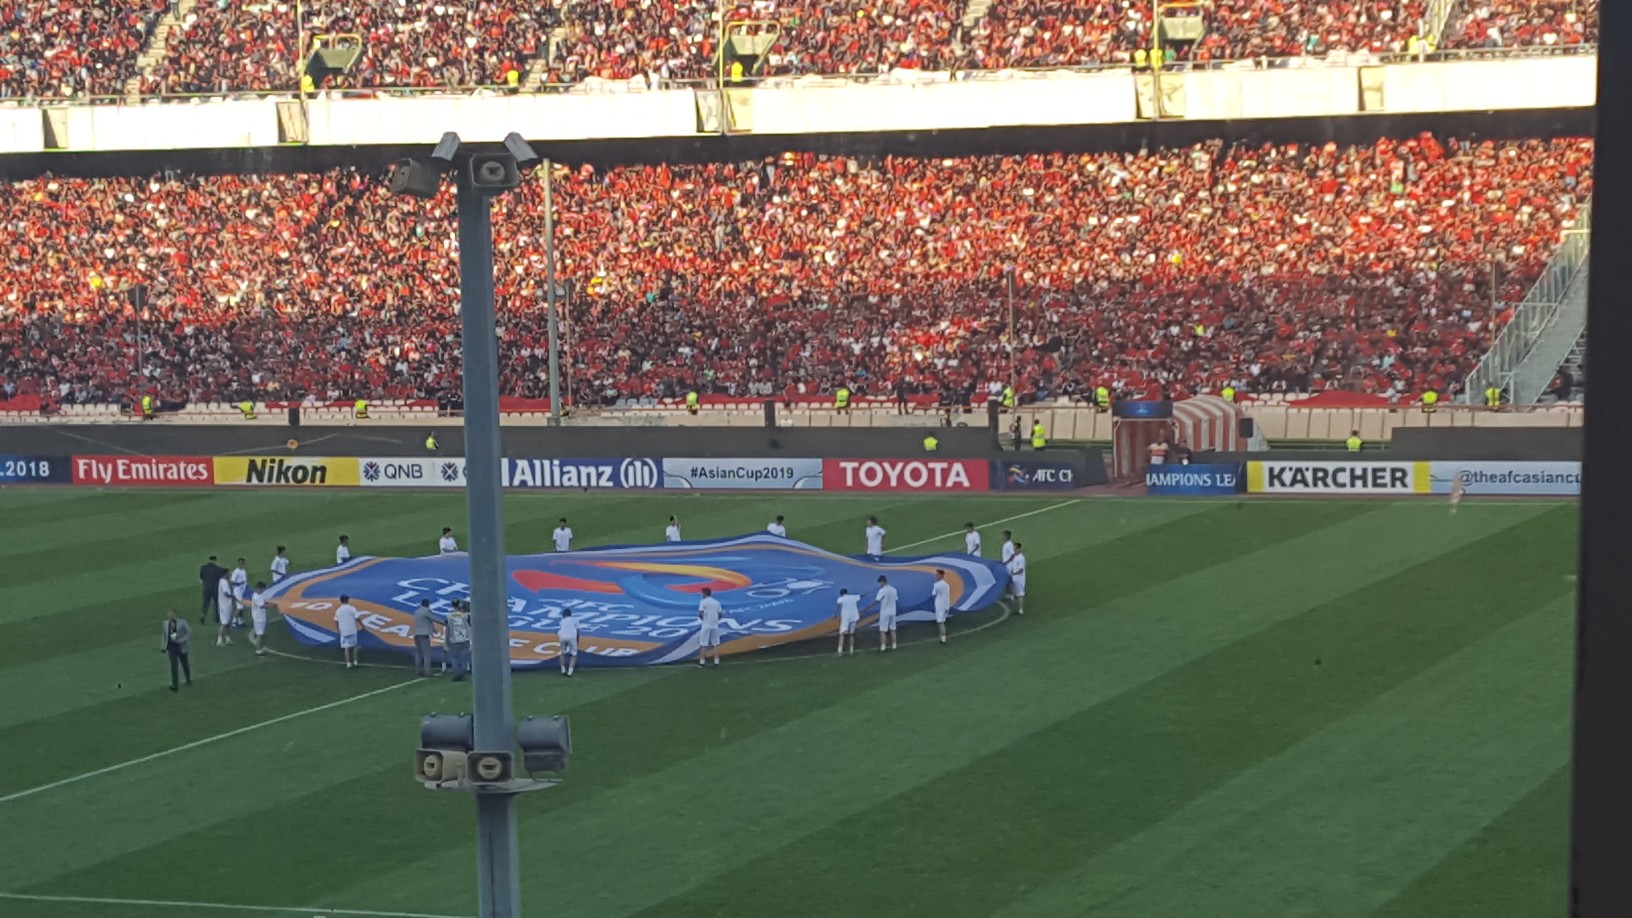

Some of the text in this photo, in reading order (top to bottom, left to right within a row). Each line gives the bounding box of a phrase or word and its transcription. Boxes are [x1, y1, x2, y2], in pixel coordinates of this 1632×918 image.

[0, 461, 50, 477] 2018
[77, 459, 208, 483] Fly Emirates
[246, 459, 327, 485] Nikon
[384, 464, 422, 480] QNB
[512, 459, 613, 487] Allianz
[690, 467, 794, 482] #AsianCup2019
[839, 461, 971, 488] TOYOTA
[1268, 466, 1408, 489] KÄRCHER
